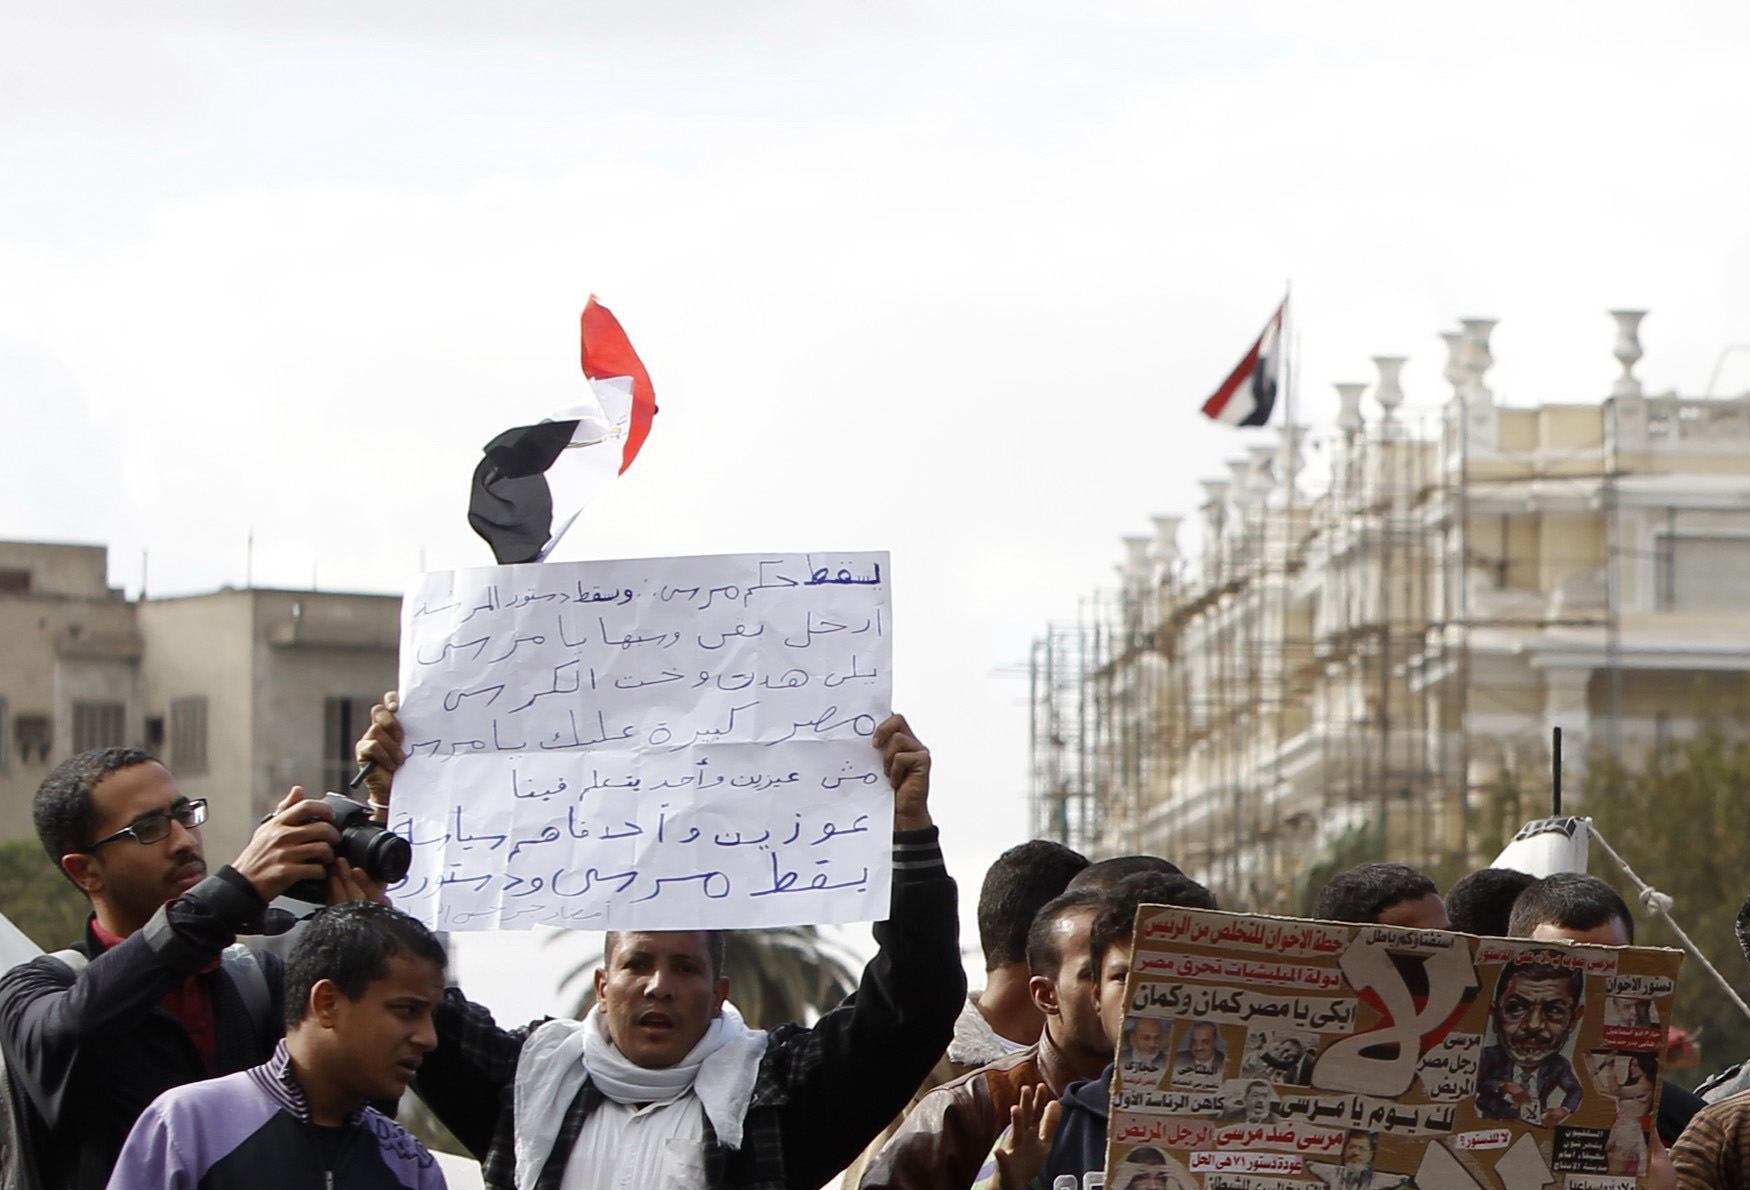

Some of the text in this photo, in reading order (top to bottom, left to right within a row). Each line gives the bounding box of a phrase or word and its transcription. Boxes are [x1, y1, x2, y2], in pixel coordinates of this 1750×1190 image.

[648, 700, 762, 753] كبيرة
[763, 705, 878, 747] مصر
[1145, 915, 1191, 940] الرئيس
[1190, 917, 1209, 942] من
[1211, 919, 1265, 945] للتخلص
[1137, 958, 1175, 972] مصر
[1131, 984, 1192, 1015] وكمان
[1193, 990, 1245, 1017] كمان
[1239, 999, 1290, 1021] مصر
[1293, 998, 1309, 1027] يا
[1416, 1057, 1449, 1072] مصر
[1351, 1096, 1365, 1127] يا
[1266, 1122, 1296, 1144] ضد
